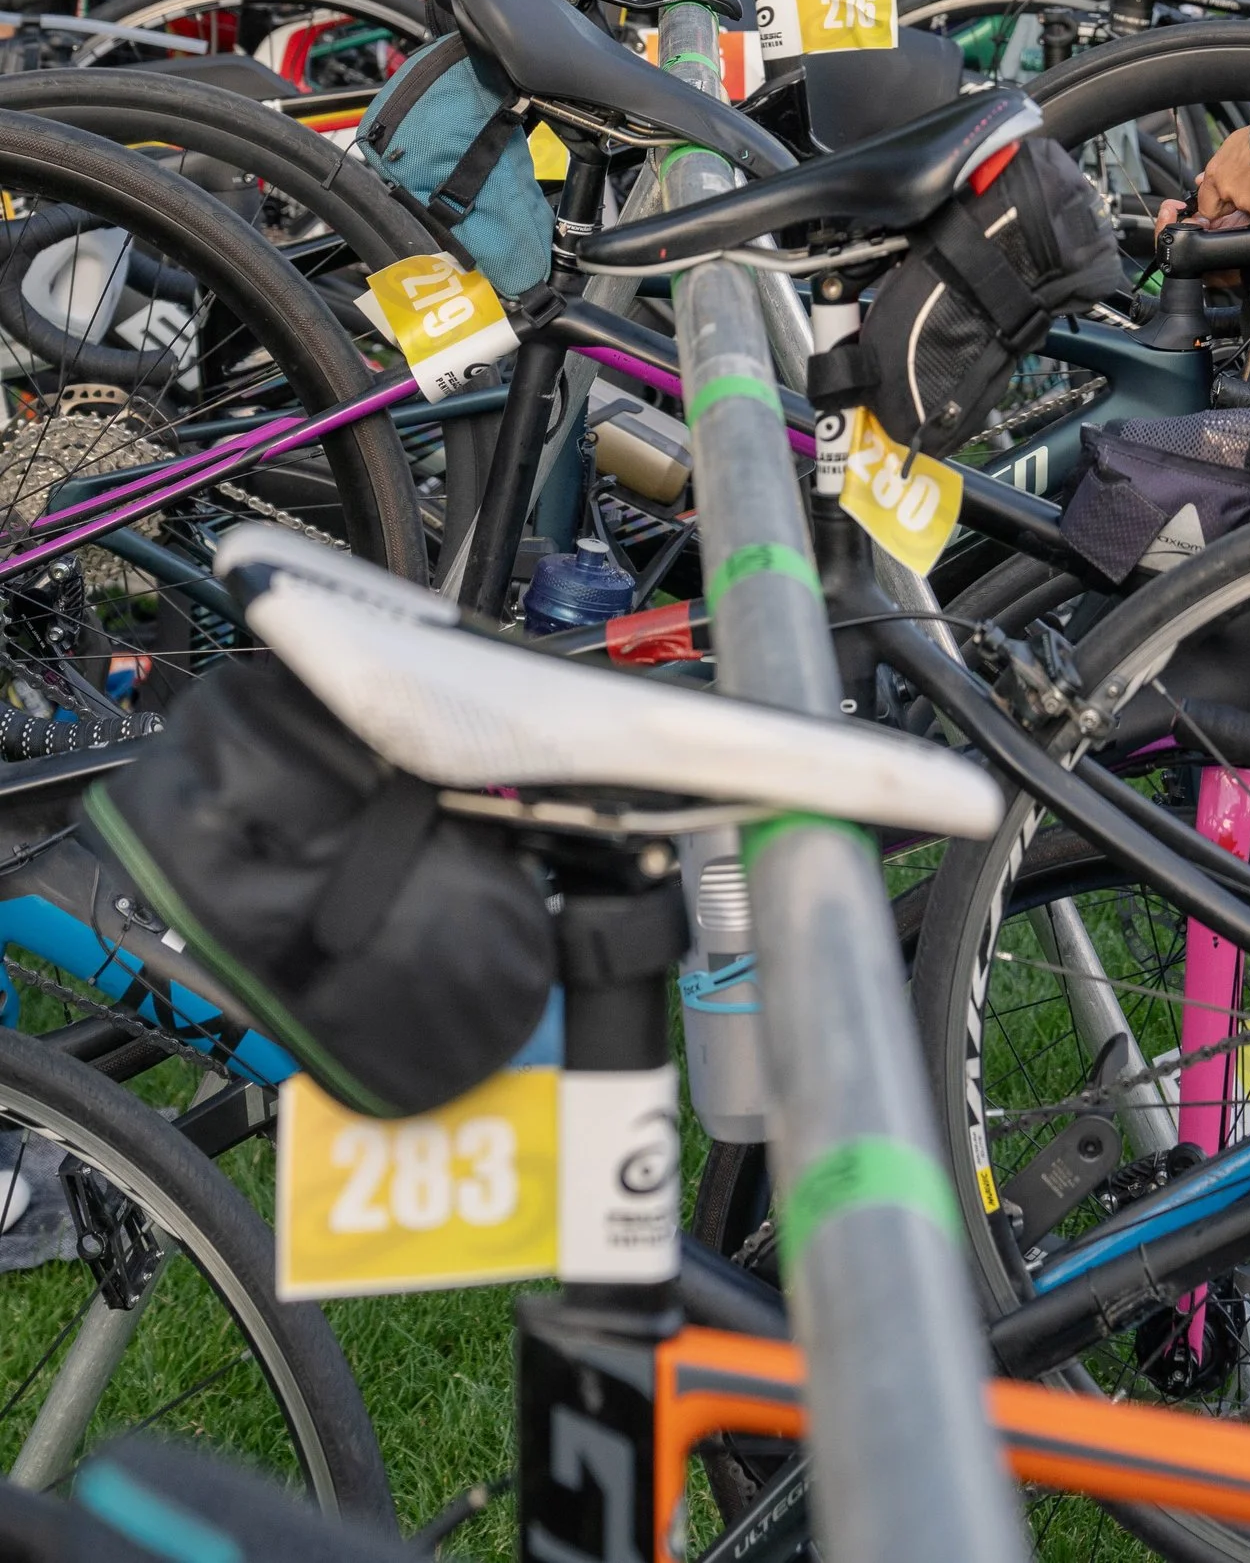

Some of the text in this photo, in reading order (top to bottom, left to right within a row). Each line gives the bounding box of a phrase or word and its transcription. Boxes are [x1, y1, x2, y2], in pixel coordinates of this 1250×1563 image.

[401, 262, 475, 338] 279
[847, 429, 941, 532] 280
[1157, 535, 1203, 551] axiom
[328, 1116, 520, 1234] 283
[733, 1479, 811, 1560] ULTEG
